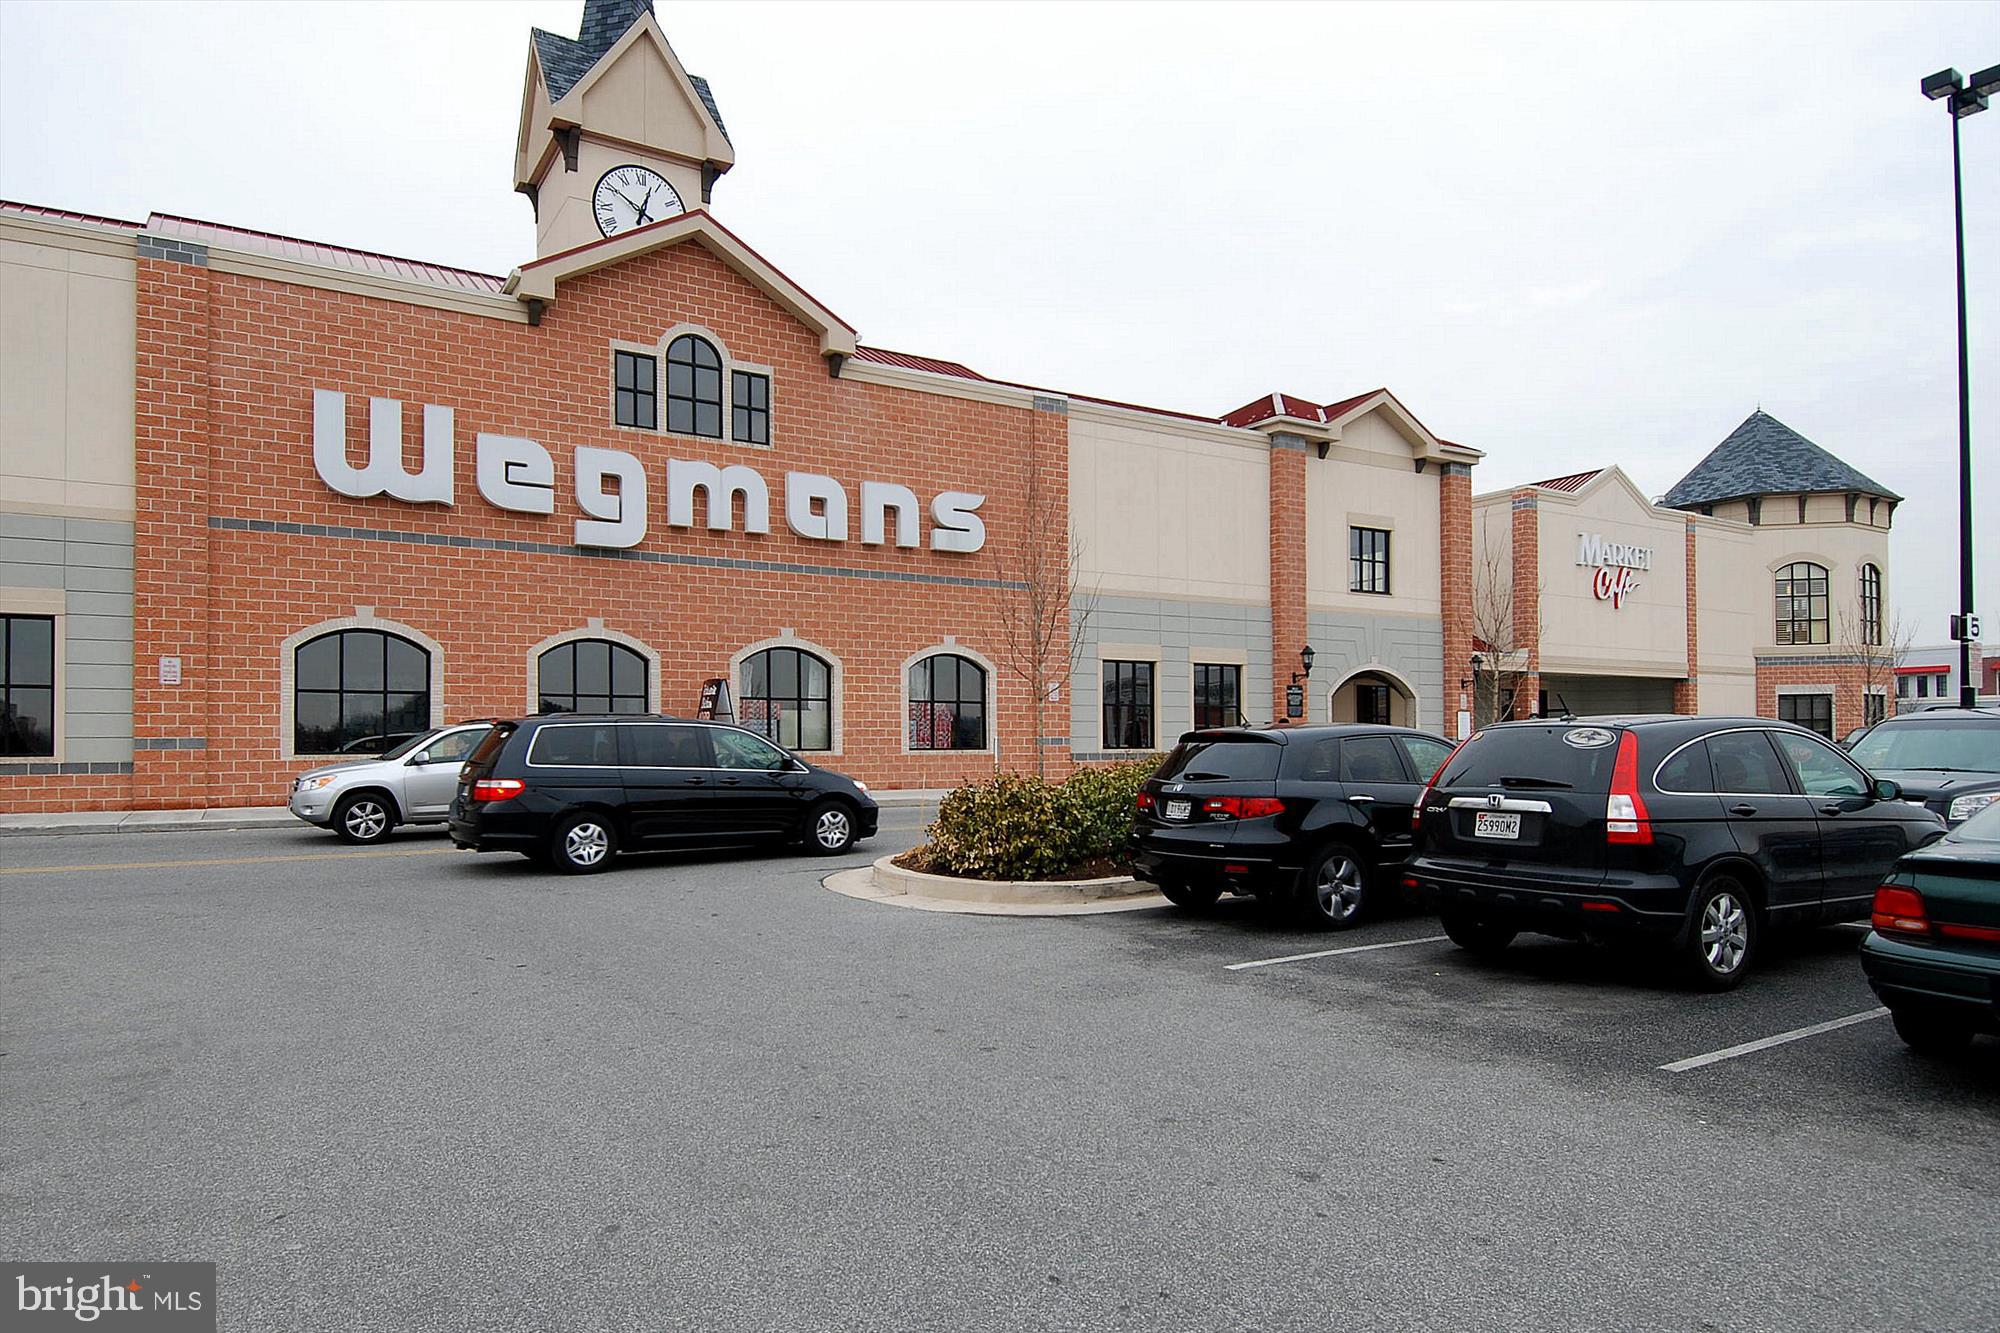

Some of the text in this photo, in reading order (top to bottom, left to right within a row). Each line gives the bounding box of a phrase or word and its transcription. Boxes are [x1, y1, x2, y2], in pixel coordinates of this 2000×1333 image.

[313, 388, 986, 550] Wegmans
[1576, 532, 1653, 571] MARKET
[1971, 616, 1980, 637] 5
